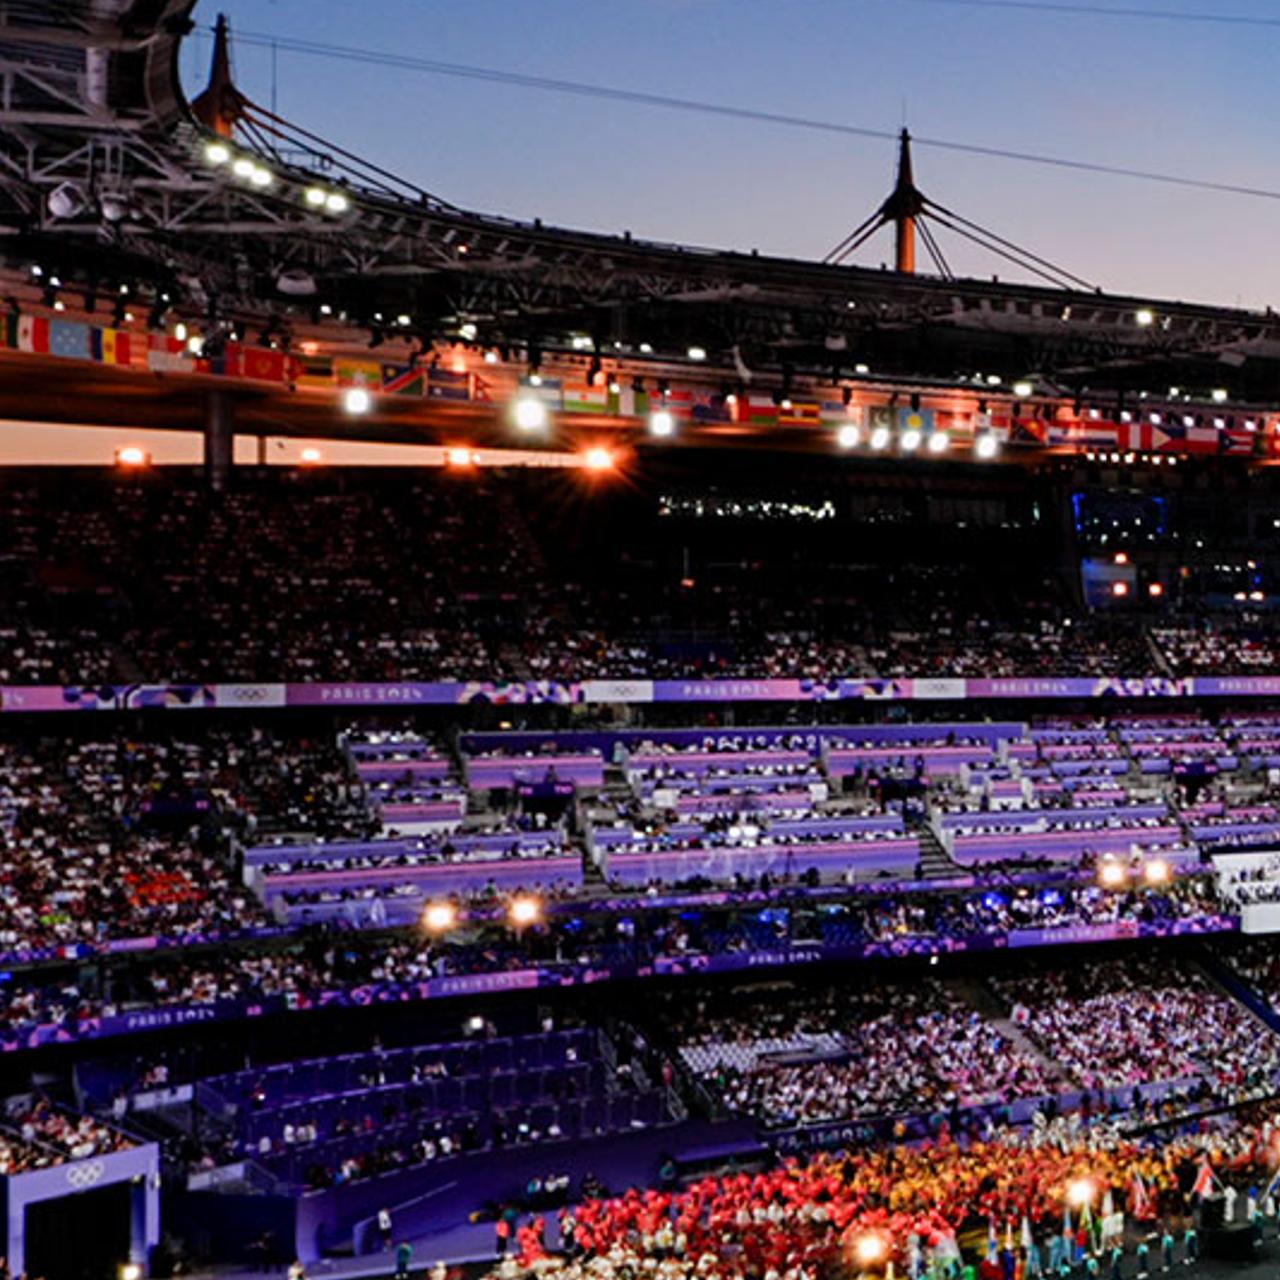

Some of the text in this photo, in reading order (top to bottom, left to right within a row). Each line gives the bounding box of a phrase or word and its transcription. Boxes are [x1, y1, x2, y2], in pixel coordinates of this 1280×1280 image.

[321, 687, 423, 699] PARIS 2024
[683, 683, 770, 696] PARIS 2024
[990, 681, 1068, 693] PARIS 2024
[441, 974, 525, 991] PARIS 2024
[128, 1008, 215, 1028] PARIS 2024
